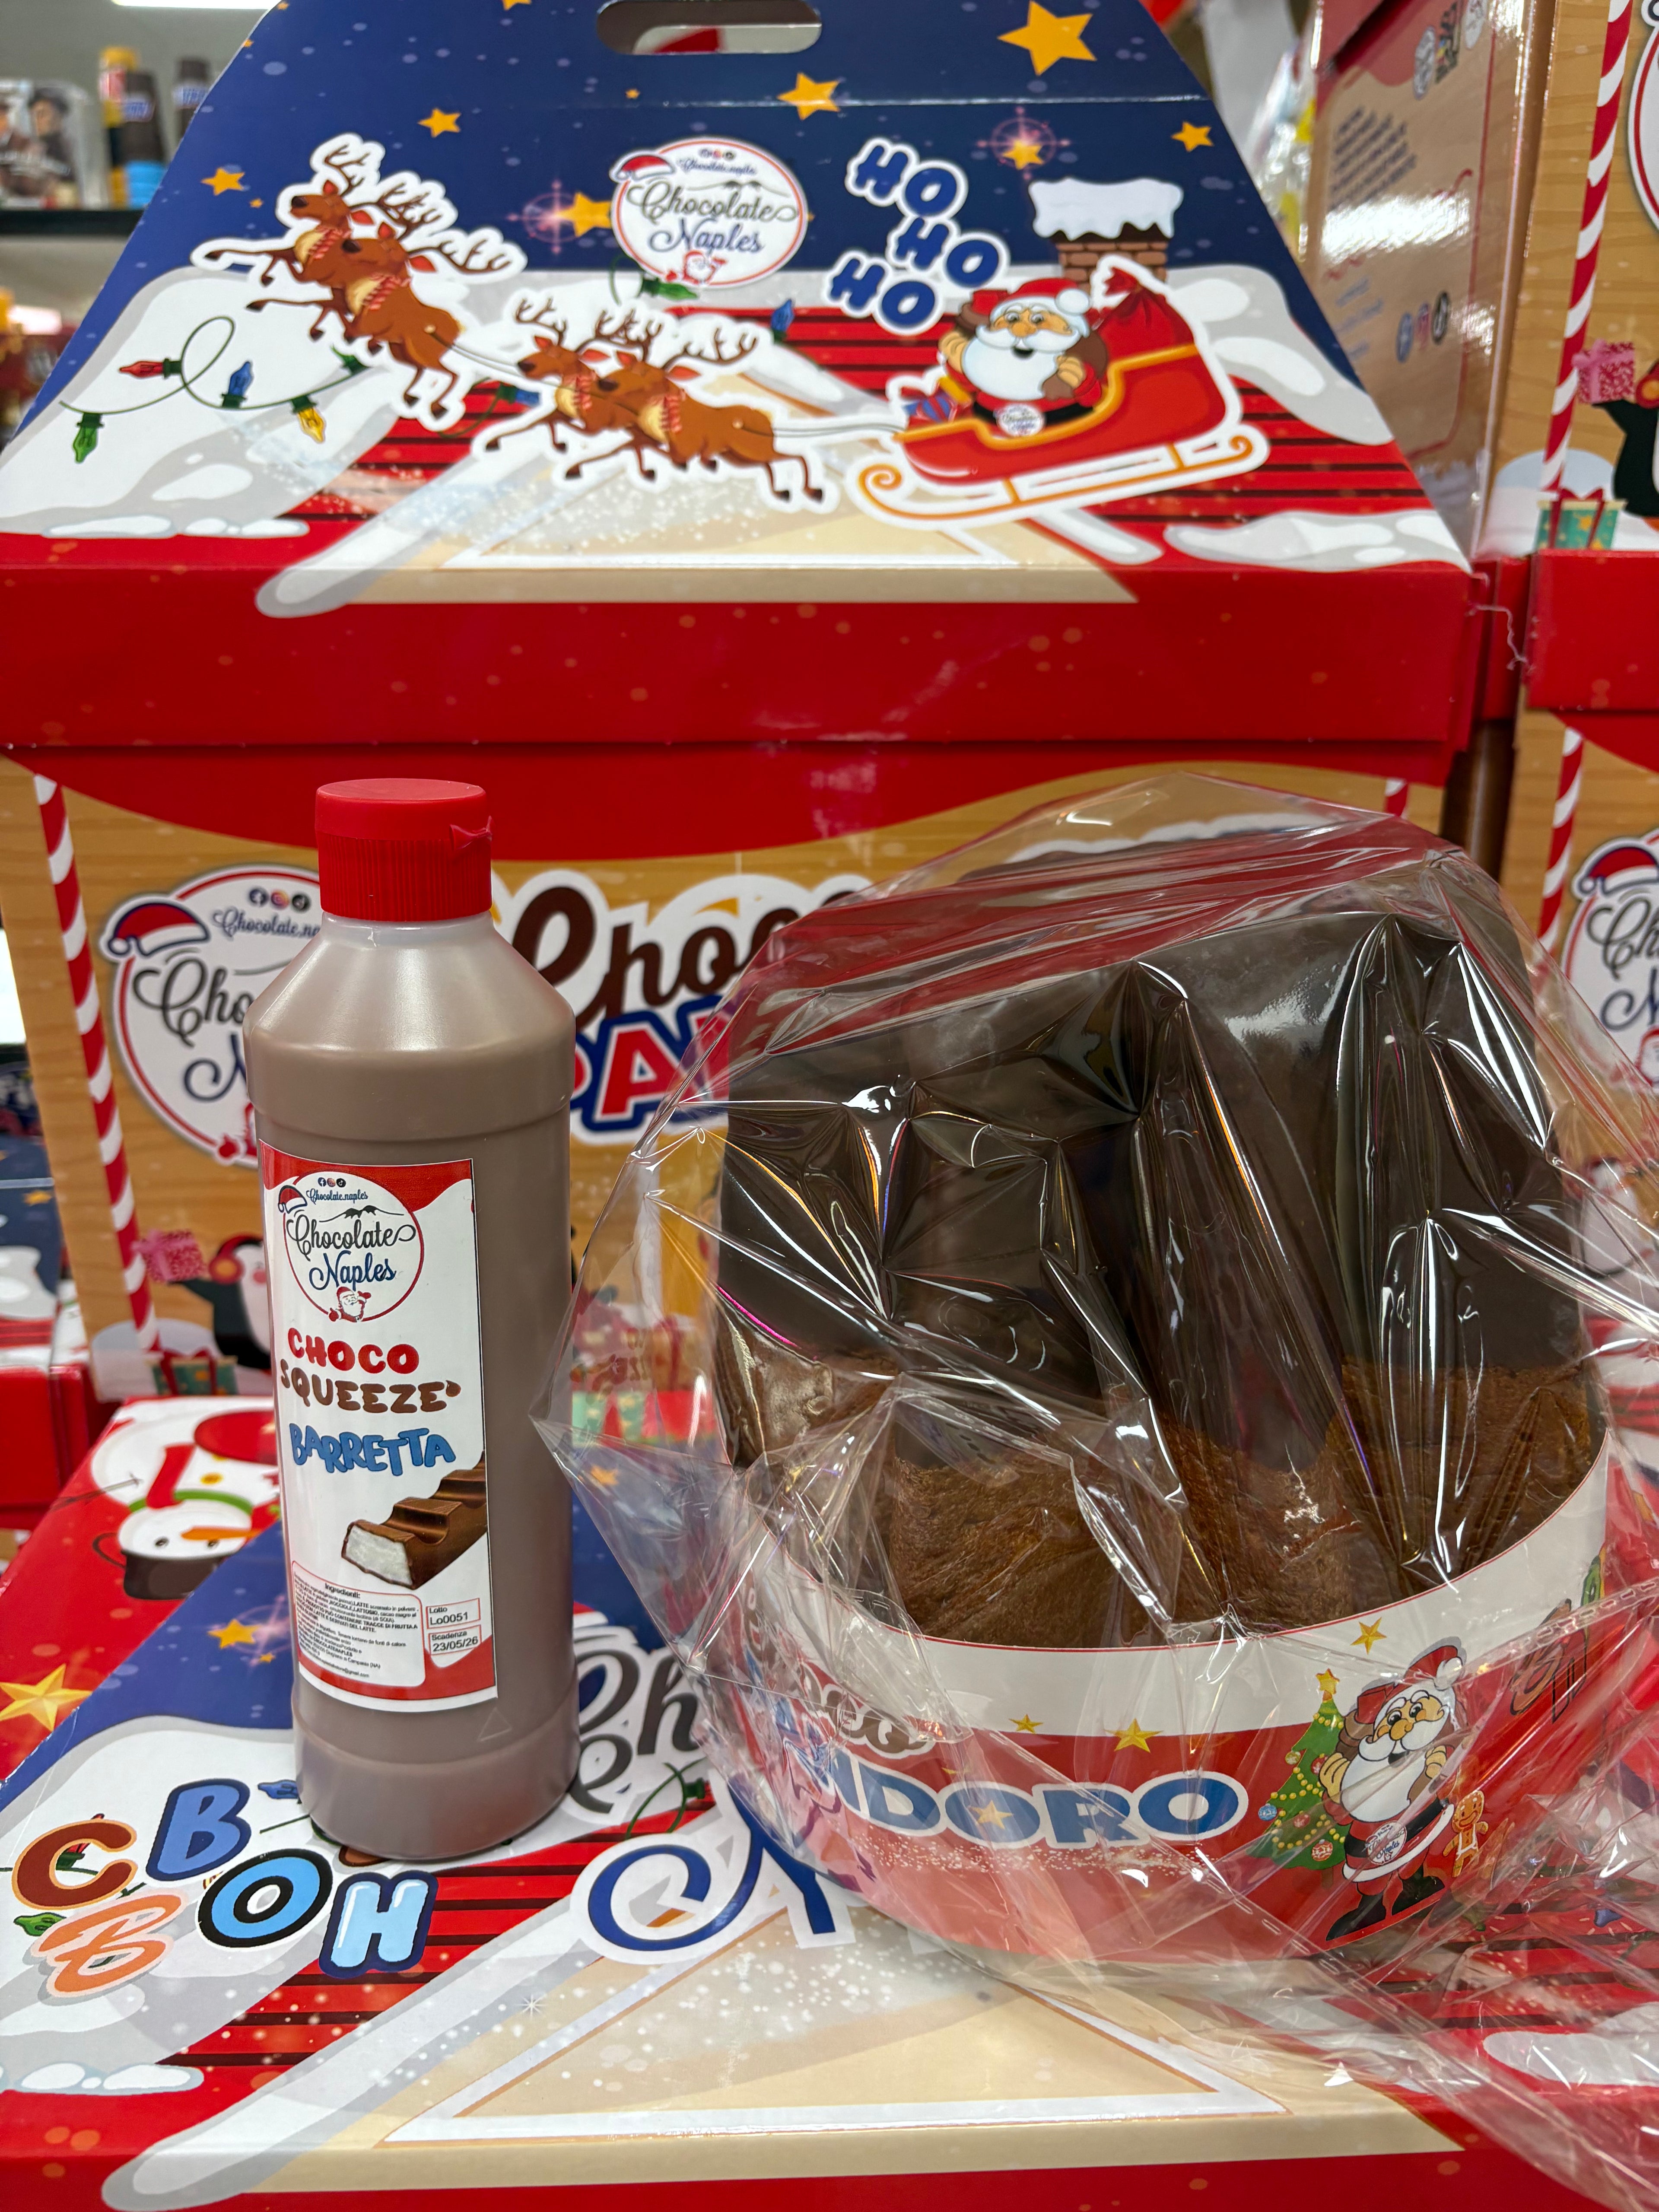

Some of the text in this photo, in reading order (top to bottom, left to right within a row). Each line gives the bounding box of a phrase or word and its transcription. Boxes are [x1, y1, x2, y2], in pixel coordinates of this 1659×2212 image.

[626, 178, 798, 225] Chocolate
[649, 218, 765, 257] Naples
[286, 1210, 416, 1262] Chocolate
[309, 1249, 397, 1292] Naples
[288, 1327, 420, 1374] CHOCO
[289, 1423, 456, 1477] BARRETTA
[432, 1630, 467, 1640] Scadenza
[433, 1636, 478, 1652] 23/05/26
